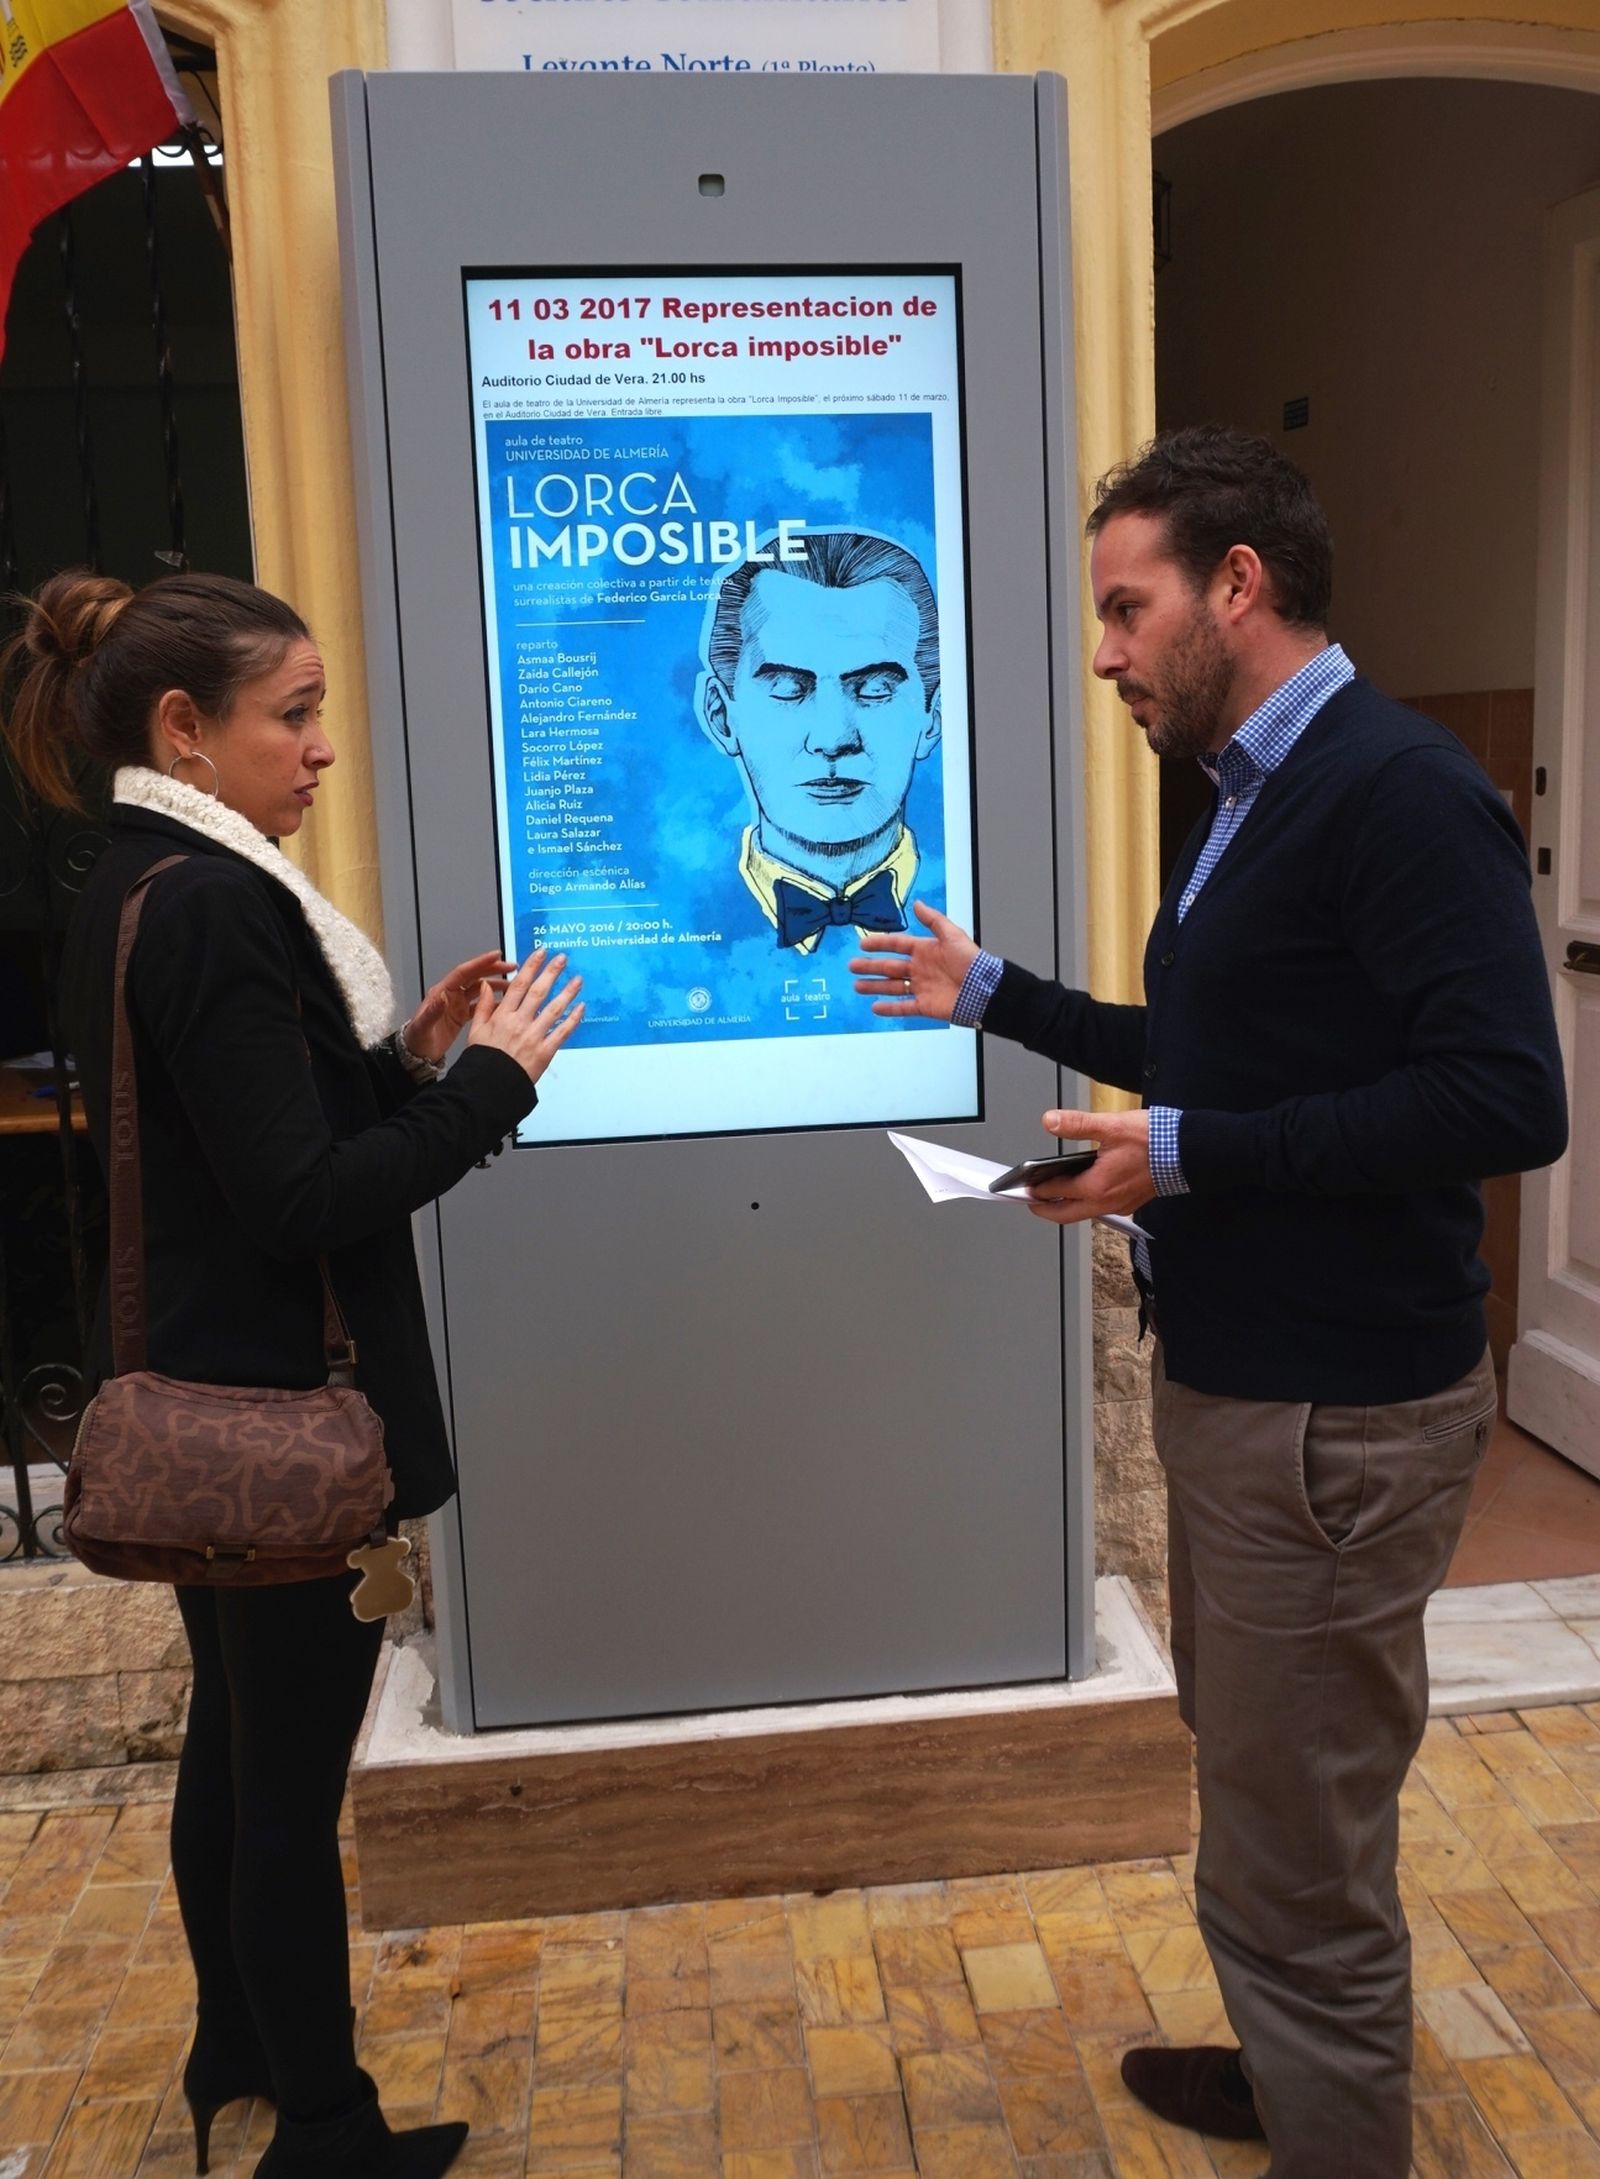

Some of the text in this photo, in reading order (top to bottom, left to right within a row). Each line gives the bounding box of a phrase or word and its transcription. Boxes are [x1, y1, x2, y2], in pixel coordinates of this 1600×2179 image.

[488, 295, 937, 323] 11 03 2017 Representacion de
[528, 334, 902, 361] la obra "Lorca imposible"
[481, 372, 706, 387] Auditorio Ciudad de Vera. 21.00 hs
[482, 400, 491, 408] El
[493, 399, 511, 408] aula
[512, 399, 523, 408] de
[525, 399, 551, 407] teatro
[553, 399, 564, 407] de
[576, 397, 623, 406] Universidad
[625, 397, 635, 405] de
[672, 397, 715, 406] representa
[717, 396, 725, 404] la
[823, 394, 831, 402] el
[832, 394, 864, 403] próximo
[910, 393, 920, 401] de
[505, 410, 541, 418] Auditorio
[543, 409, 571, 417] Ciudad
[573, 409, 584, 417] de
[610, 408, 643, 416] Entrada
[505, 435, 583, 446] aula de teatro
[506, 443, 669, 461] UNIVERSIDAD DE ALMERÍA
[507, 471, 698, 518] LORCA
[509, 519, 809, 569] IMPOSIBLE
[513, 575, 733, 592] una creación colectiva a partir de textos
[514, 590, 721, 607] surrealistas de Federico García Lorca
[516, 640, 558, 652] reparto
[517, 652, 597, 665] Asmaa Bousrij
[518, 666, 599, 680] Zaida Callejón
[518, 682, 583, 695] Darío Cano
[519, 696, 613, 709] Antonio Ciareno
[520, 709, 638, 726] Alejandro Fernández
[521, 726, 600, 738] Lara Hermosa
[521, 740, 604, 753] Socorro López
[522, 755, 603, 767] Félix Martínez
[523, 770, 586, 782] Lidia Pérez
[524, 784, 594, 798] Juanjo Plaza
[525, 799, 583, 811] Alicia Ruiz
[525, 813, 614, 826] Daniel Requena
[526, 827, 601, 840] Laura Salazar
[527, 840, 623, 855] e Ismael Sánchez
[528, 865, 630, 880] dirección escénica
[529, 878, 646, 895] Diego Armando Alías
[533, 919, 673, 935] 26 MAYO 2016 / 20:00 h.
[534, 931, 722, 949] Paraninfo Universidad de Almería
[781, 993, 831, 1003] aula teatro
[648, 1017, 702, 1028] UNIVERSIDAD
[704, 1017, 716, 1025] DE
